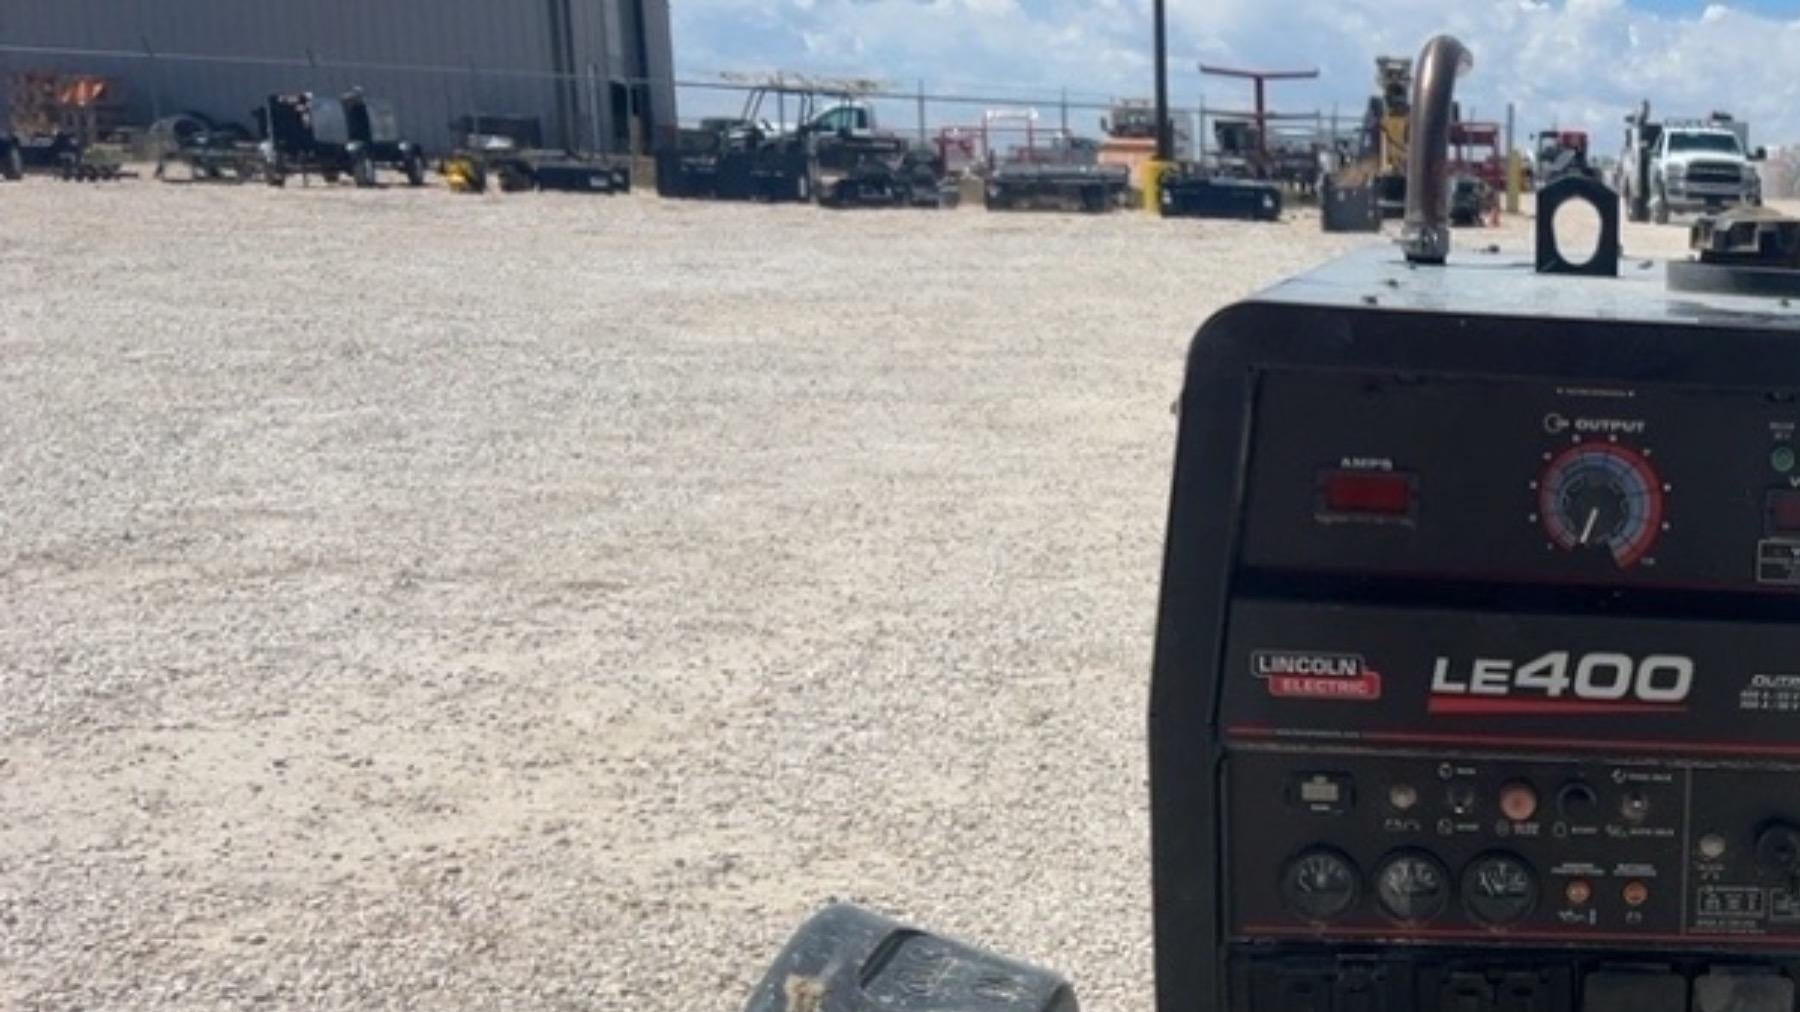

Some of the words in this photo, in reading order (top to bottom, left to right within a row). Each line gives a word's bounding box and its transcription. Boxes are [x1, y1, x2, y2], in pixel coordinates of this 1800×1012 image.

[1574, 419, 1646, 434] OUTPUT
[1340, 457, 1393, 471] AMPS
[1257, 655, 1358, 677] LINCOLN
[1430, 651, 1694, 702] LE400
[1281, 677, 1369, 695] ELECTRIC
